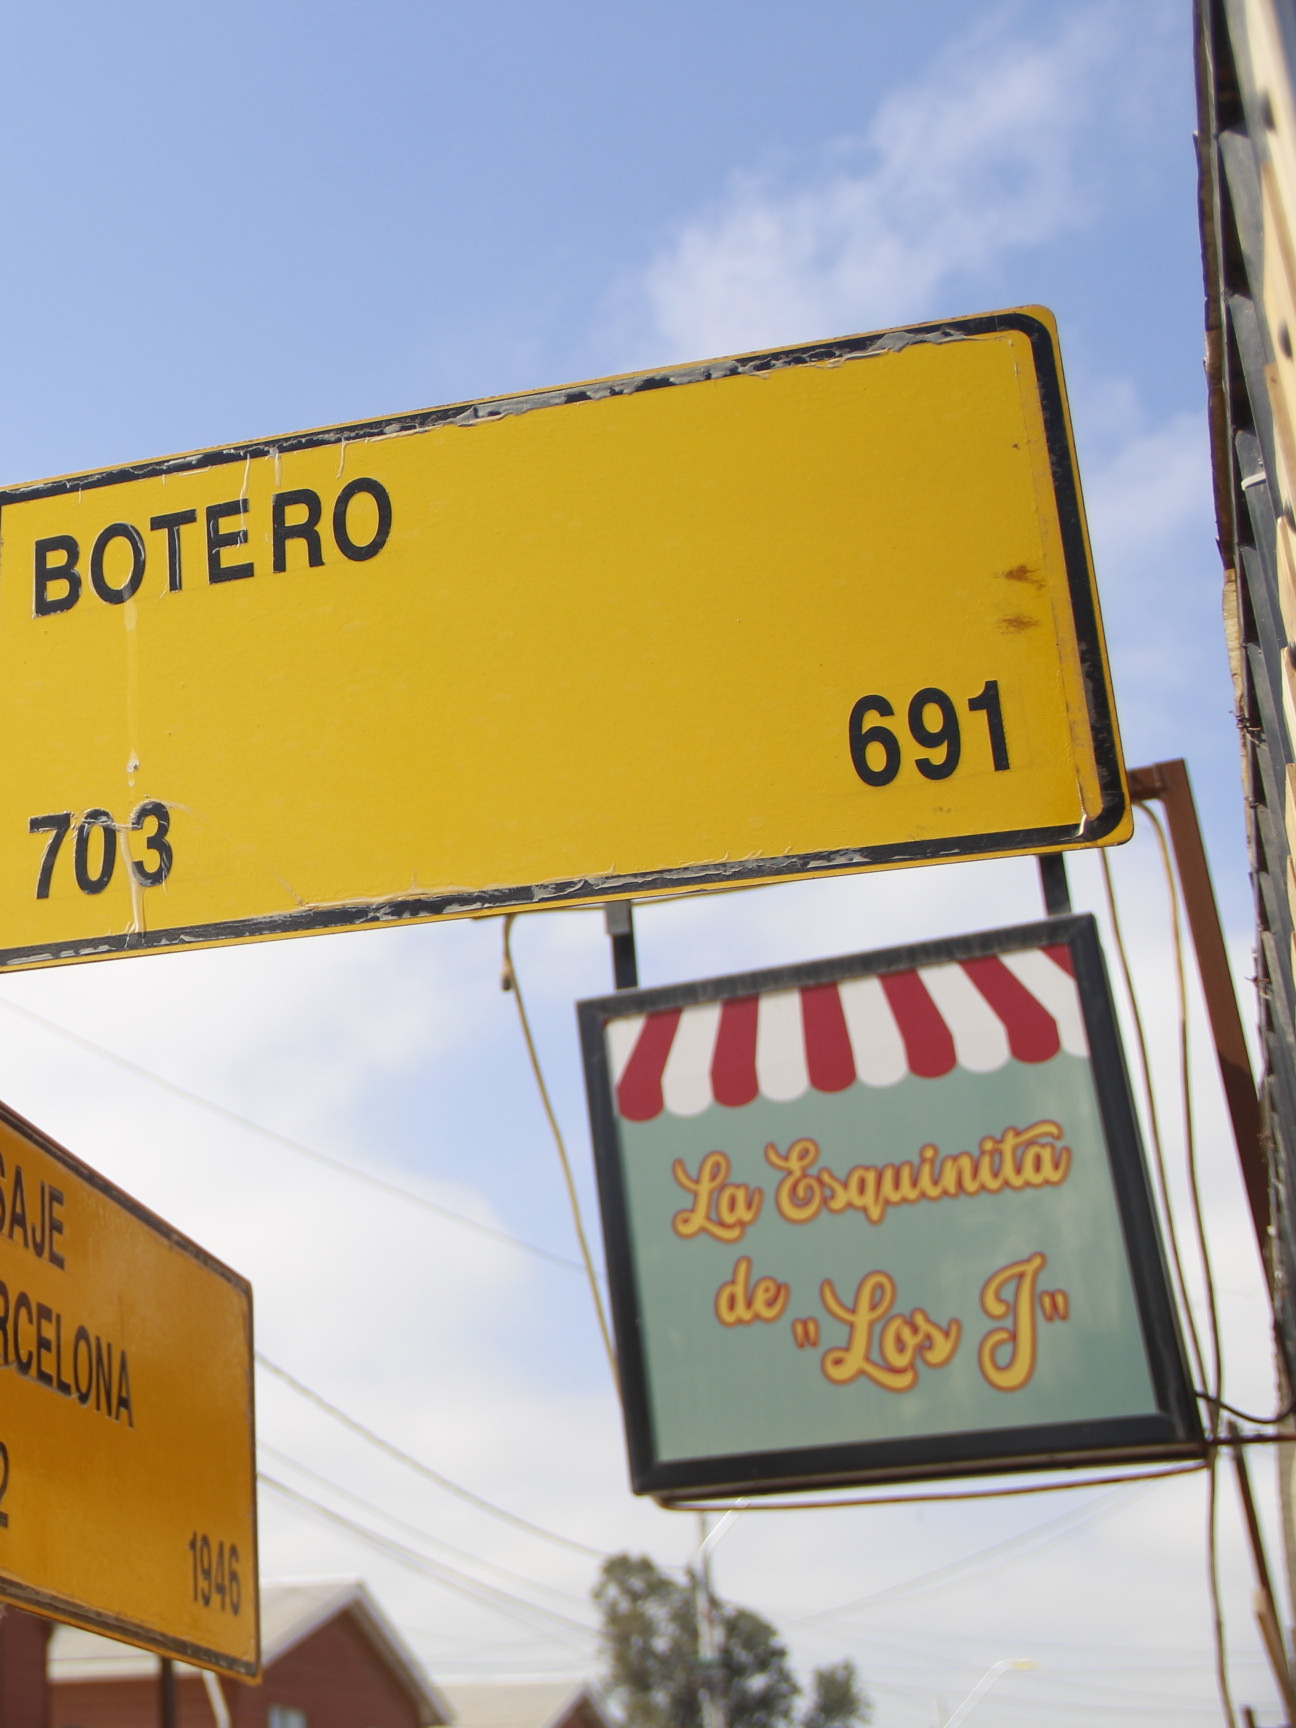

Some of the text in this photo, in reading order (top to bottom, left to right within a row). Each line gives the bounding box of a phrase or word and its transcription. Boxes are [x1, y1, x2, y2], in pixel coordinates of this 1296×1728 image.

[34, 477, 393, 618] BOTERO
[849, 680, 1010, 787] 691
[28, 800, 174, 900] 703
[672, 1120, 1072, 1244] La Esquinita
[713, 1255, 790, 1327] de
[189, 1530, 242, 1616] 1946
